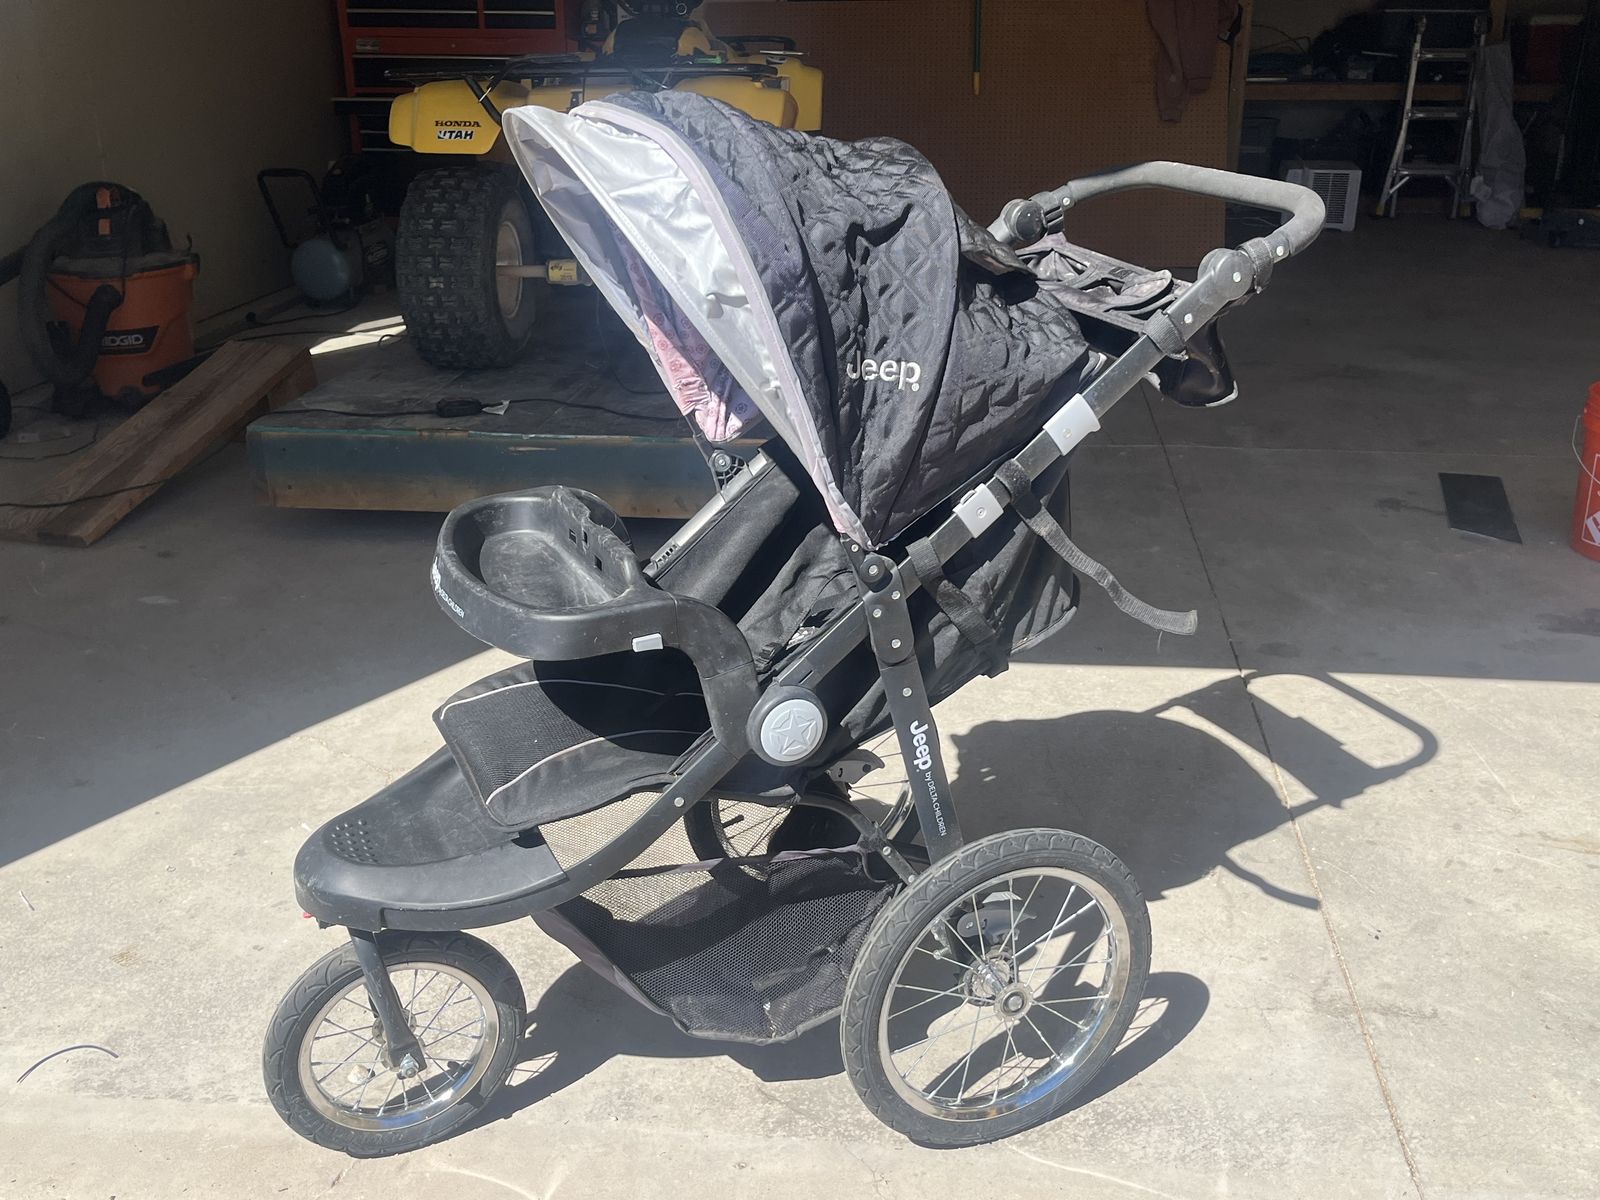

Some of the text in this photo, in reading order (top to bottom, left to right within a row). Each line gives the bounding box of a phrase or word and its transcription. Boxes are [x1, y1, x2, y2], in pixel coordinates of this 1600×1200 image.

[434, 120, 481, 128] HONDA
[437, 130, 474, 140] UTAH
[846, 350, 921, 391] Jeep
[909, 720, 948, 837] Jeep by DELTA CHILDREN
